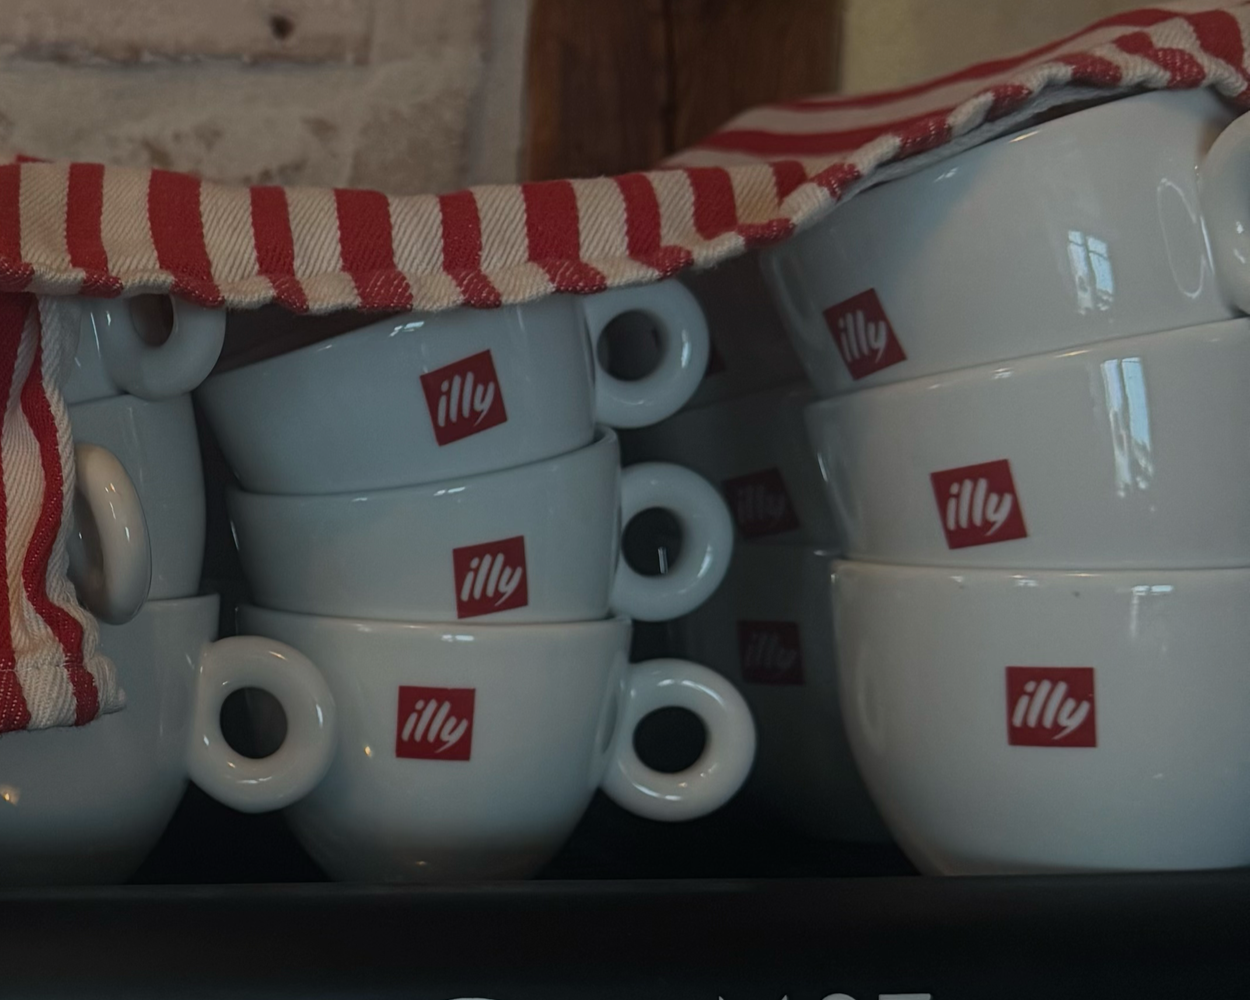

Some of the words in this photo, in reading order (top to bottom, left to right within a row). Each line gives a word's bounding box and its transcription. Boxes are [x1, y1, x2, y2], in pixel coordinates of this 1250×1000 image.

[839, 310, 889, 360] illy
[437, 371, 495, 427] illy
[946, 478, 1014, 536] illy
[460, 553, 524, 606] illy
[401, 698, 468, 752] illy
[1011, 679, 1091, 740] illy
